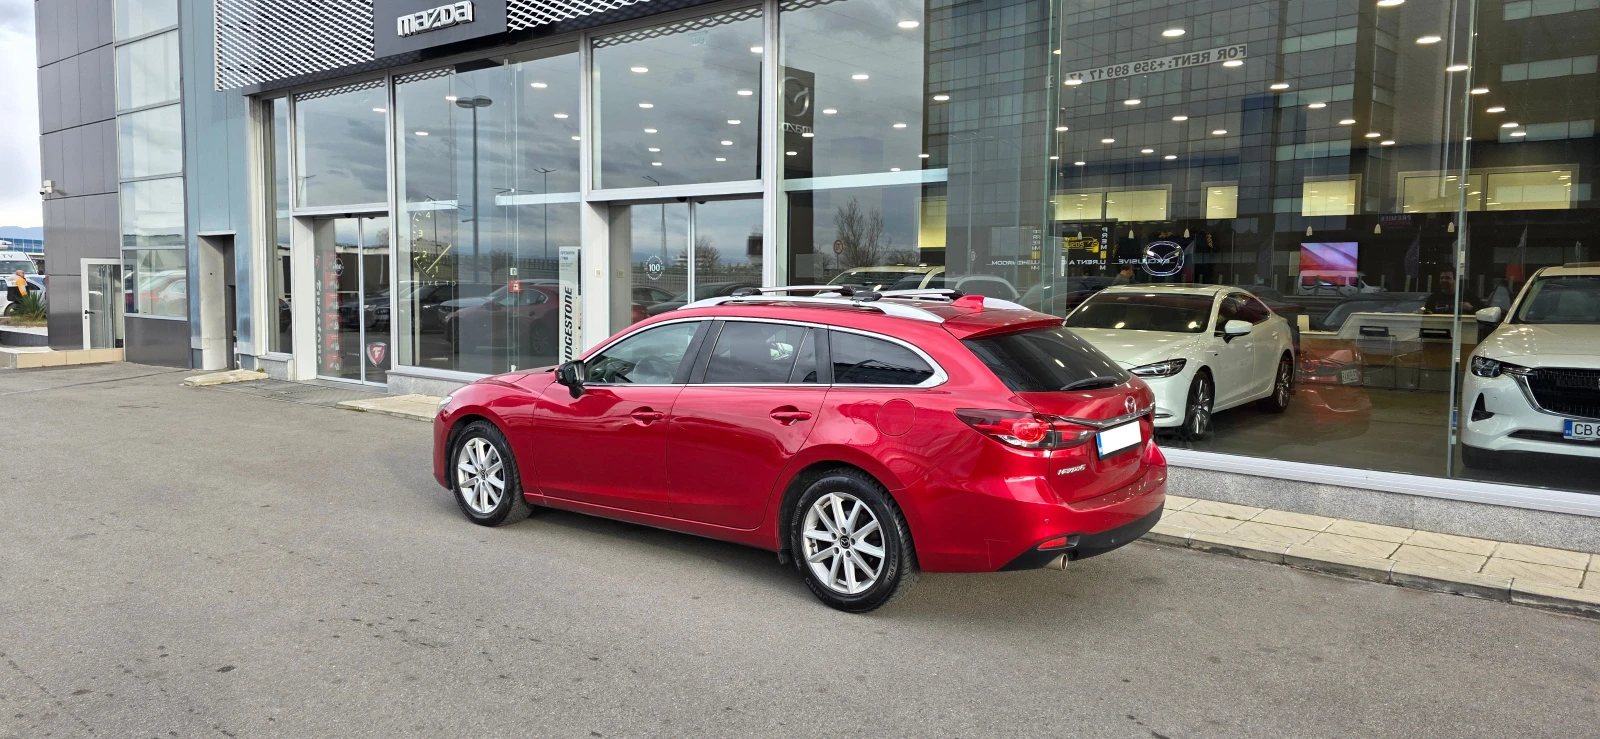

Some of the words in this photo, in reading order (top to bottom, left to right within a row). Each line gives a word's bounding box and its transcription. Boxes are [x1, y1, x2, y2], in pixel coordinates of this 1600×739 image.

[397, 0, 473, 37] mazda
[649, 263, 660, 271] 100
[1575, 424, 1593, 435] CB
